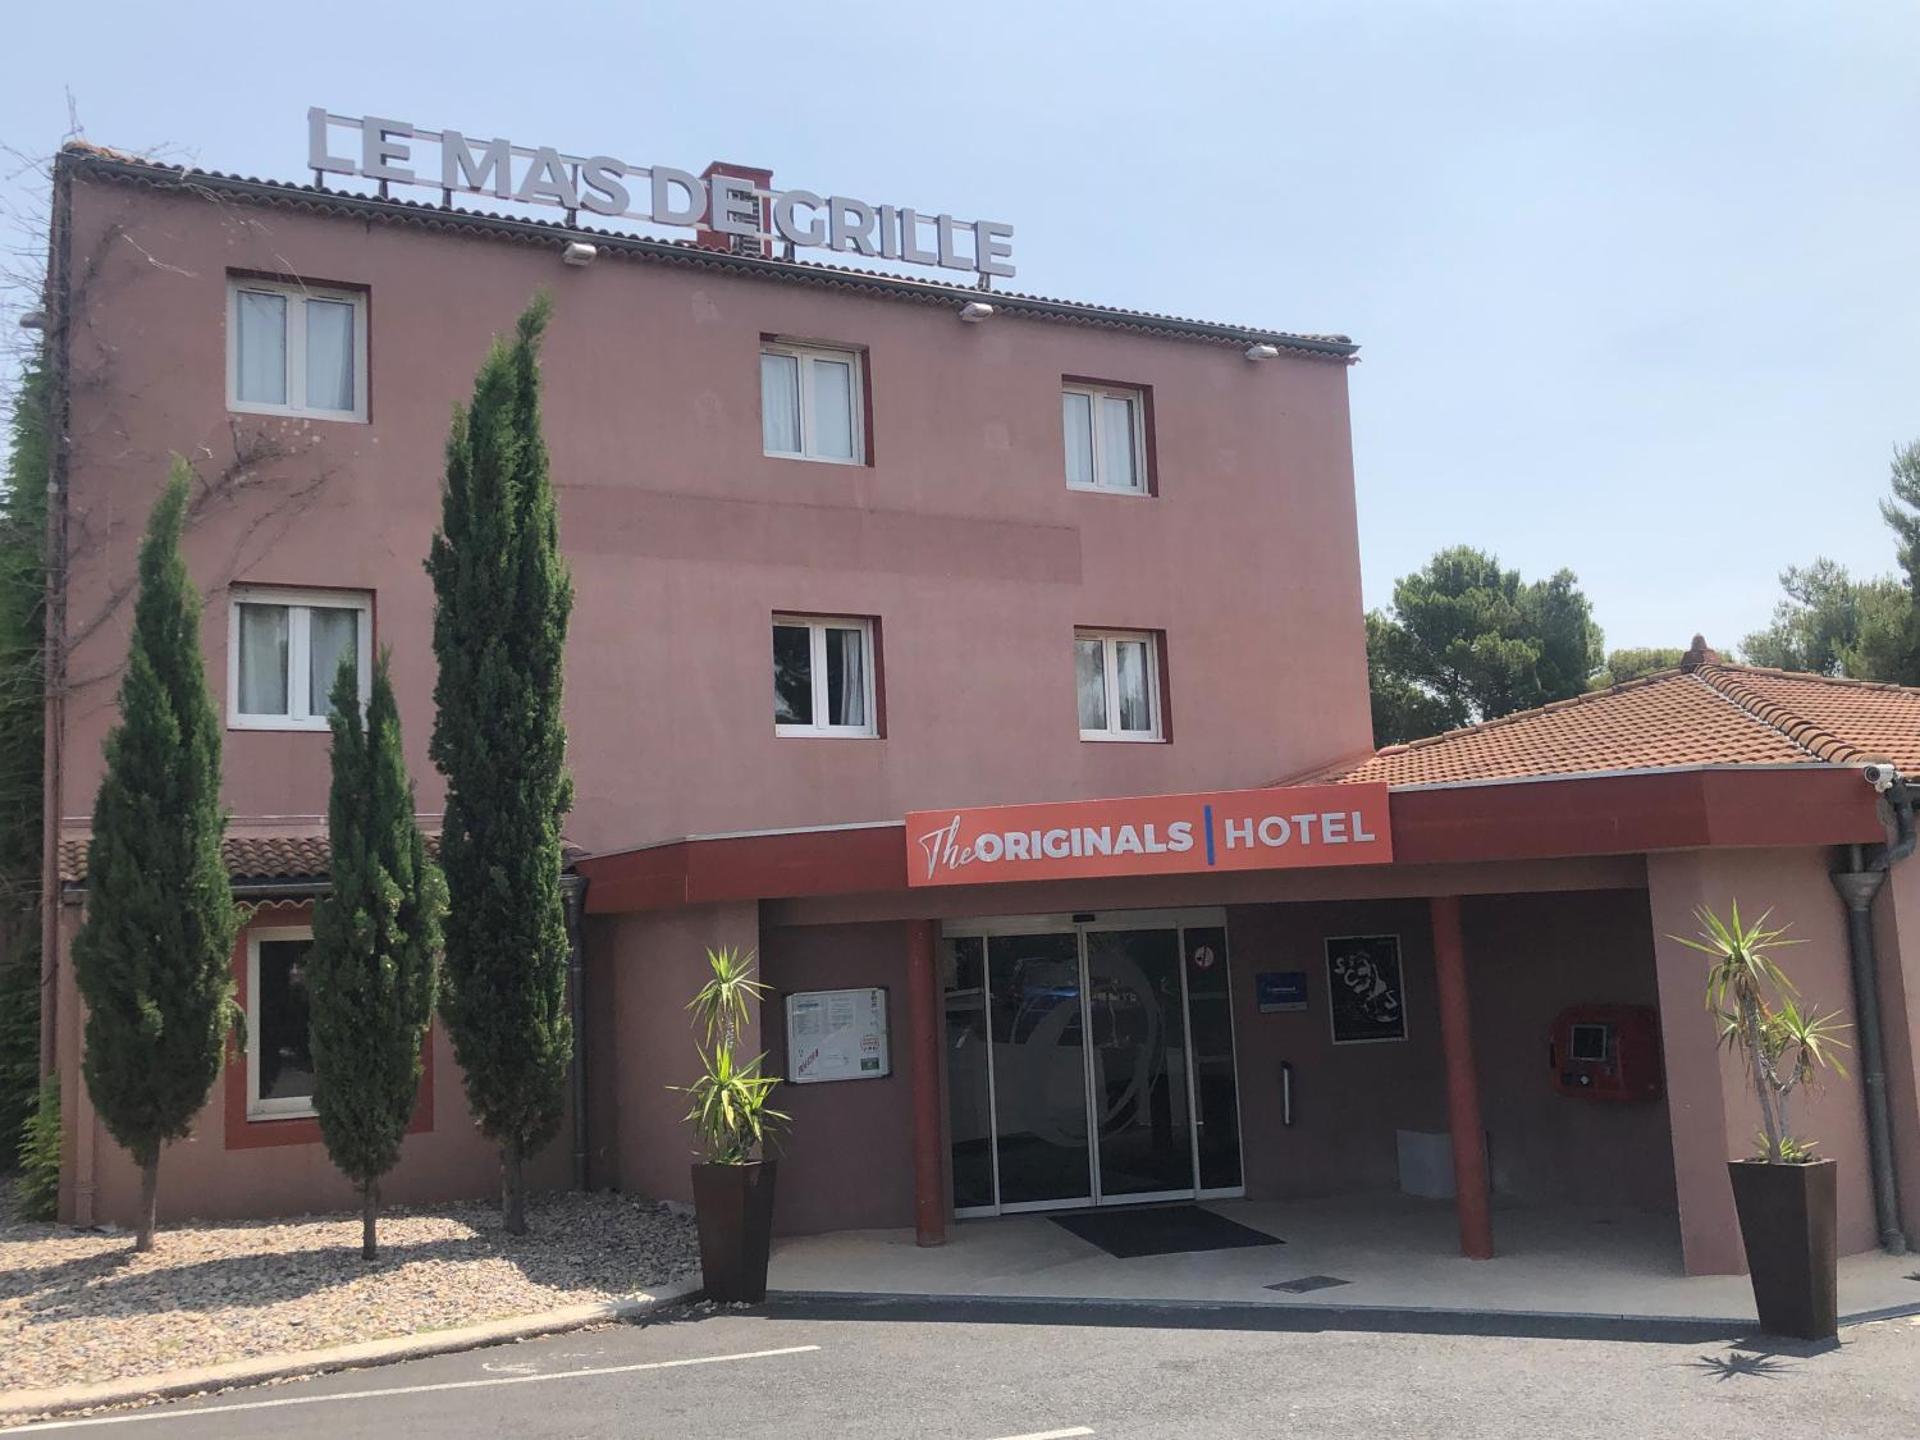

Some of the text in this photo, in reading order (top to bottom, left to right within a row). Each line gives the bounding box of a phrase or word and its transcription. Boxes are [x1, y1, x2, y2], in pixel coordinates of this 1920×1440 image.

[308, 106, 1016, 277] LE MAS DE GRILLE
[920, 811, 1376, 880] The ORIGINALS HOTEL
